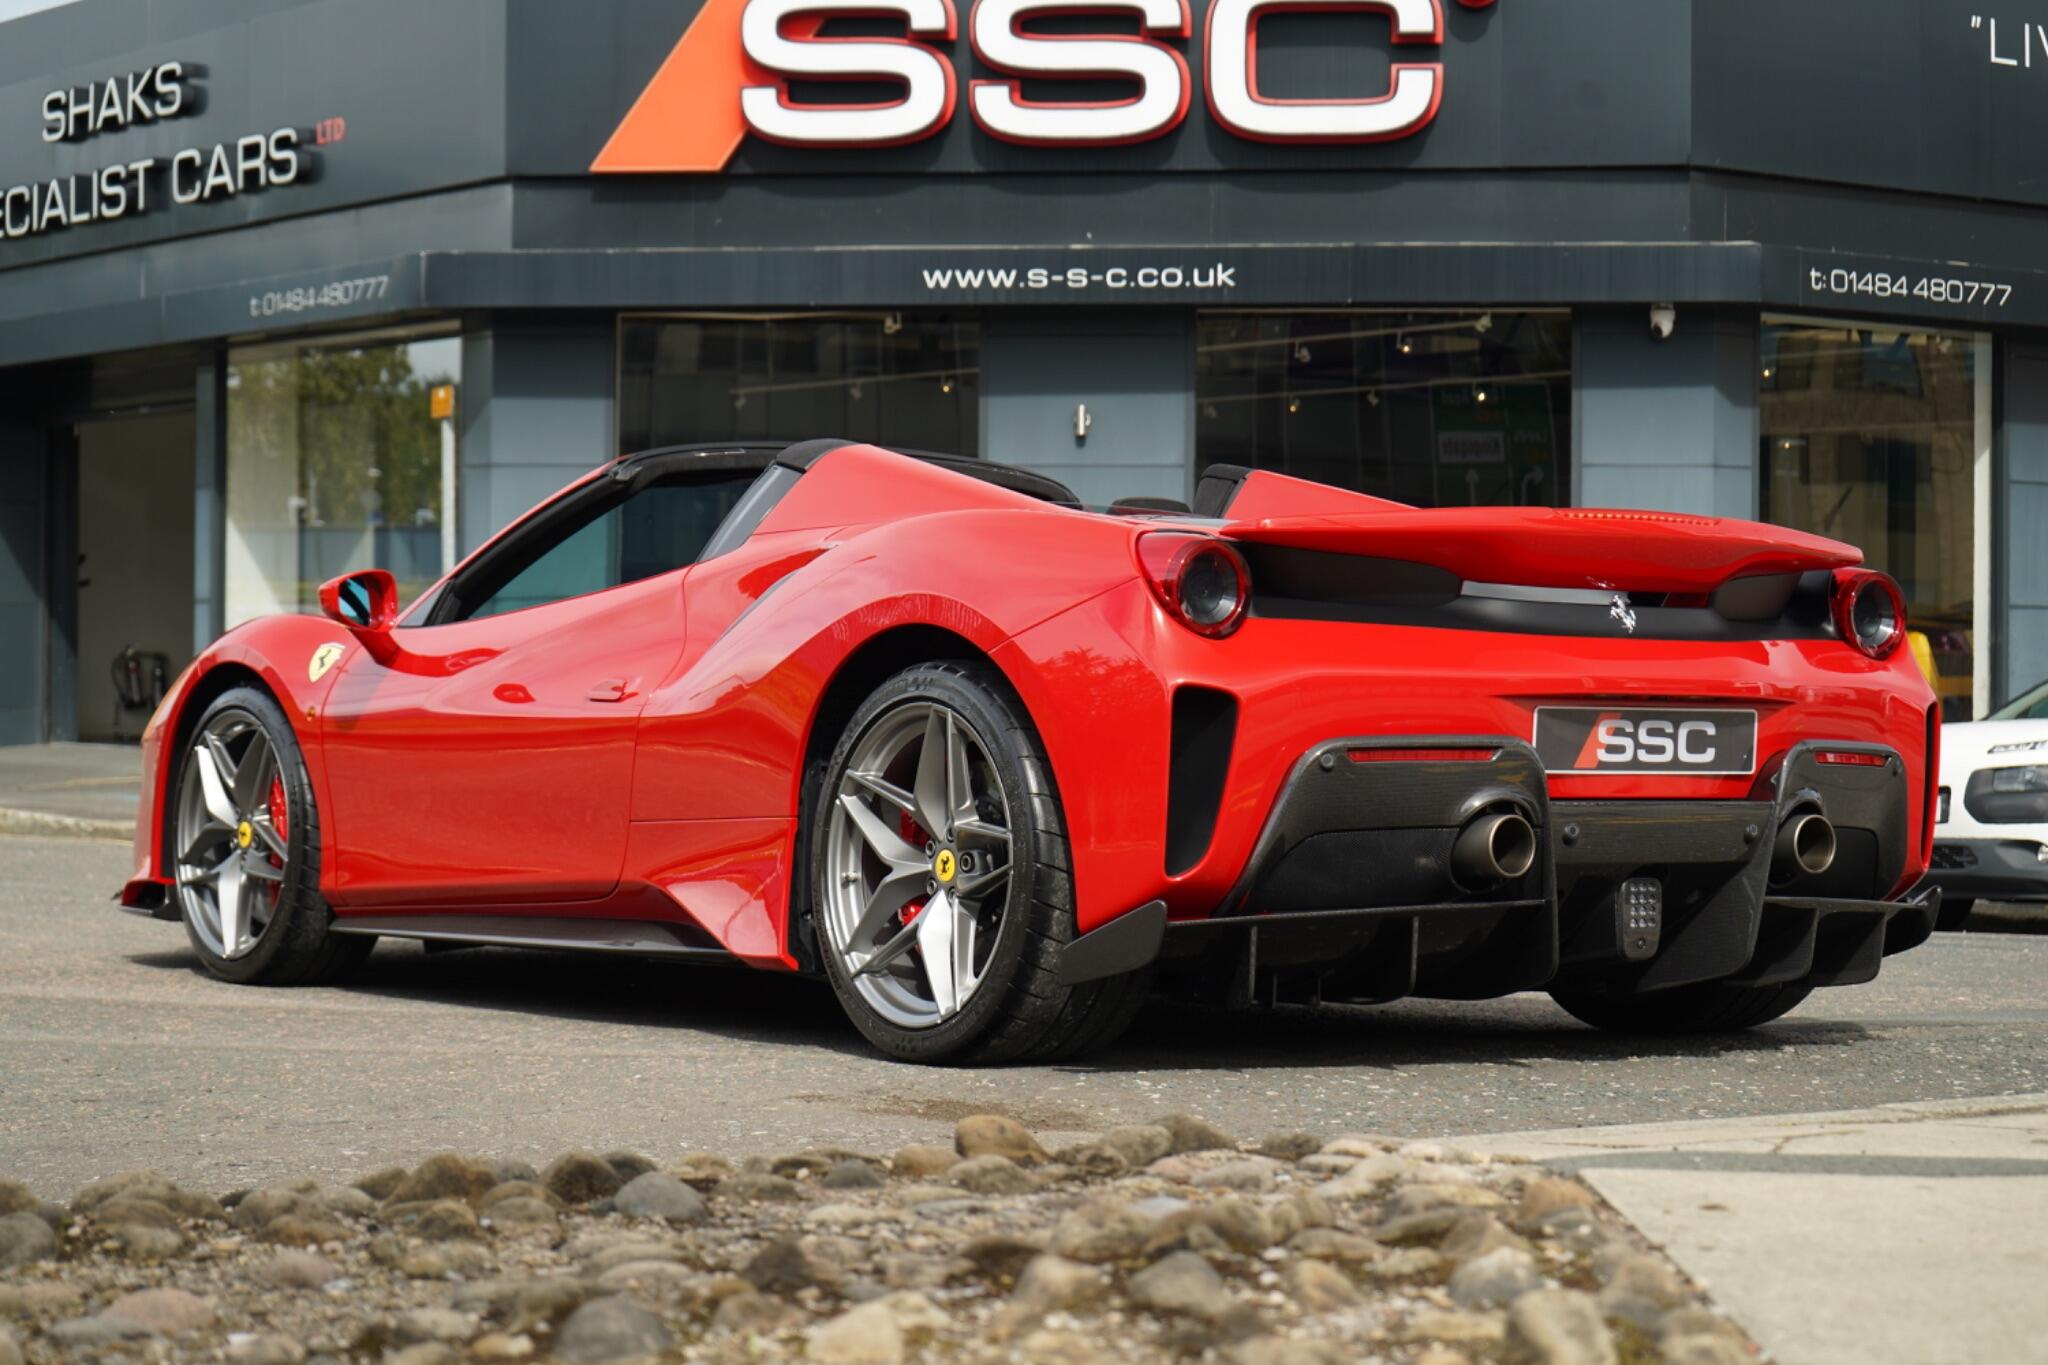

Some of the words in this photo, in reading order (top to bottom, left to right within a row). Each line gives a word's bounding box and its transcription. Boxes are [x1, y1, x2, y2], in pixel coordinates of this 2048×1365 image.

[42, 61, 182, 142] SHAKS
[740, 0, 1443, 148] SSC
[0, 158, 155, 239] CIALIST
[171, 127, 298, 203] CARS
[315, 116, 346, 145] LTD
[922, 262, 1236, 289] www.s-s-c.co.uk
[1912, 277, 2013, 307] 480777
[1596, 719, 1717, 763] SSC
